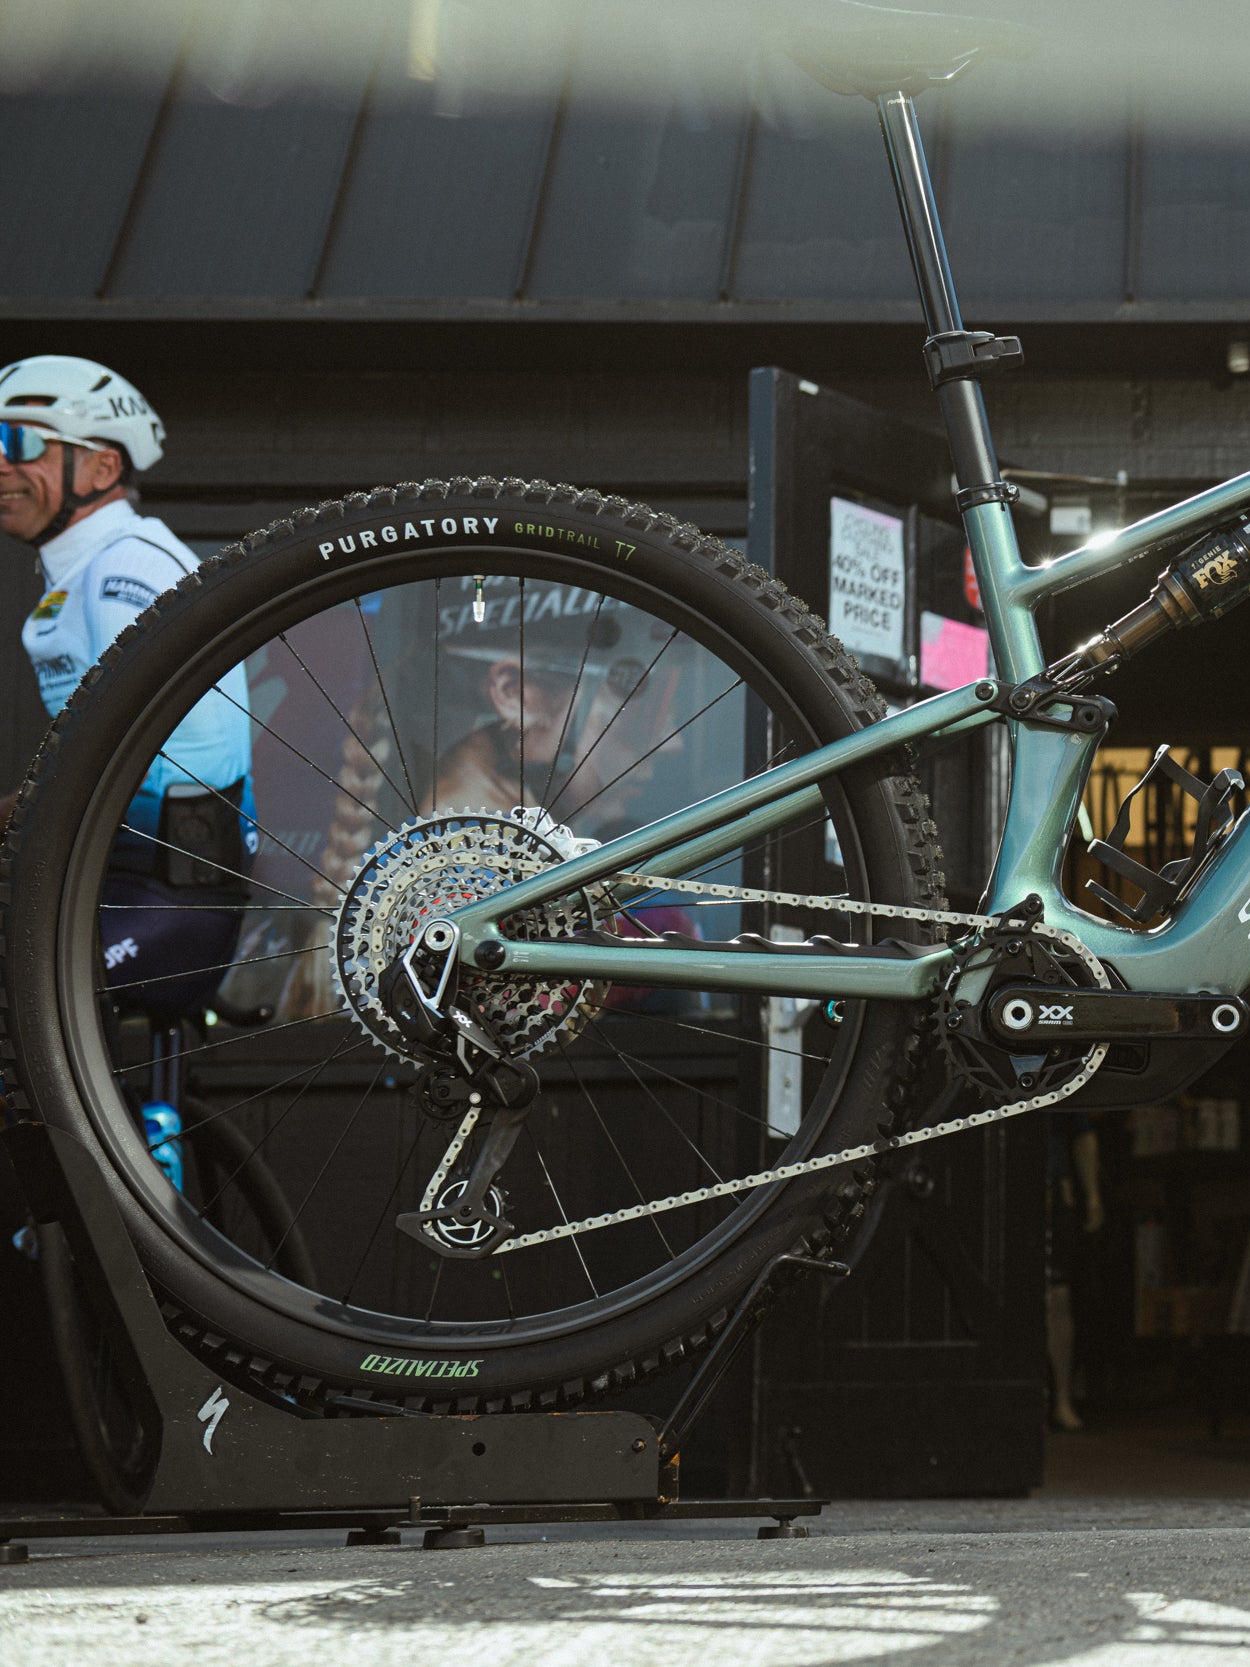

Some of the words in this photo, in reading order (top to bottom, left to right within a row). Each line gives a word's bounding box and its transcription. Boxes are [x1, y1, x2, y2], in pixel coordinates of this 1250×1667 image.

[318, 517, 499, 561] PURGATORY
[614, 540, 637, 561] T7
[1198, 545, 1222, 566] GENIE
[870, 564, 900, 587] OFF
[1191, 549, 1239, 590] FOX
[834, 576, 899, 611] MARKED
[844, 602, 890, 631] PRICE
[1038, 1004, 1074, 1020] XX
[360, 1354, 484, 1378] SPECIALIZED
